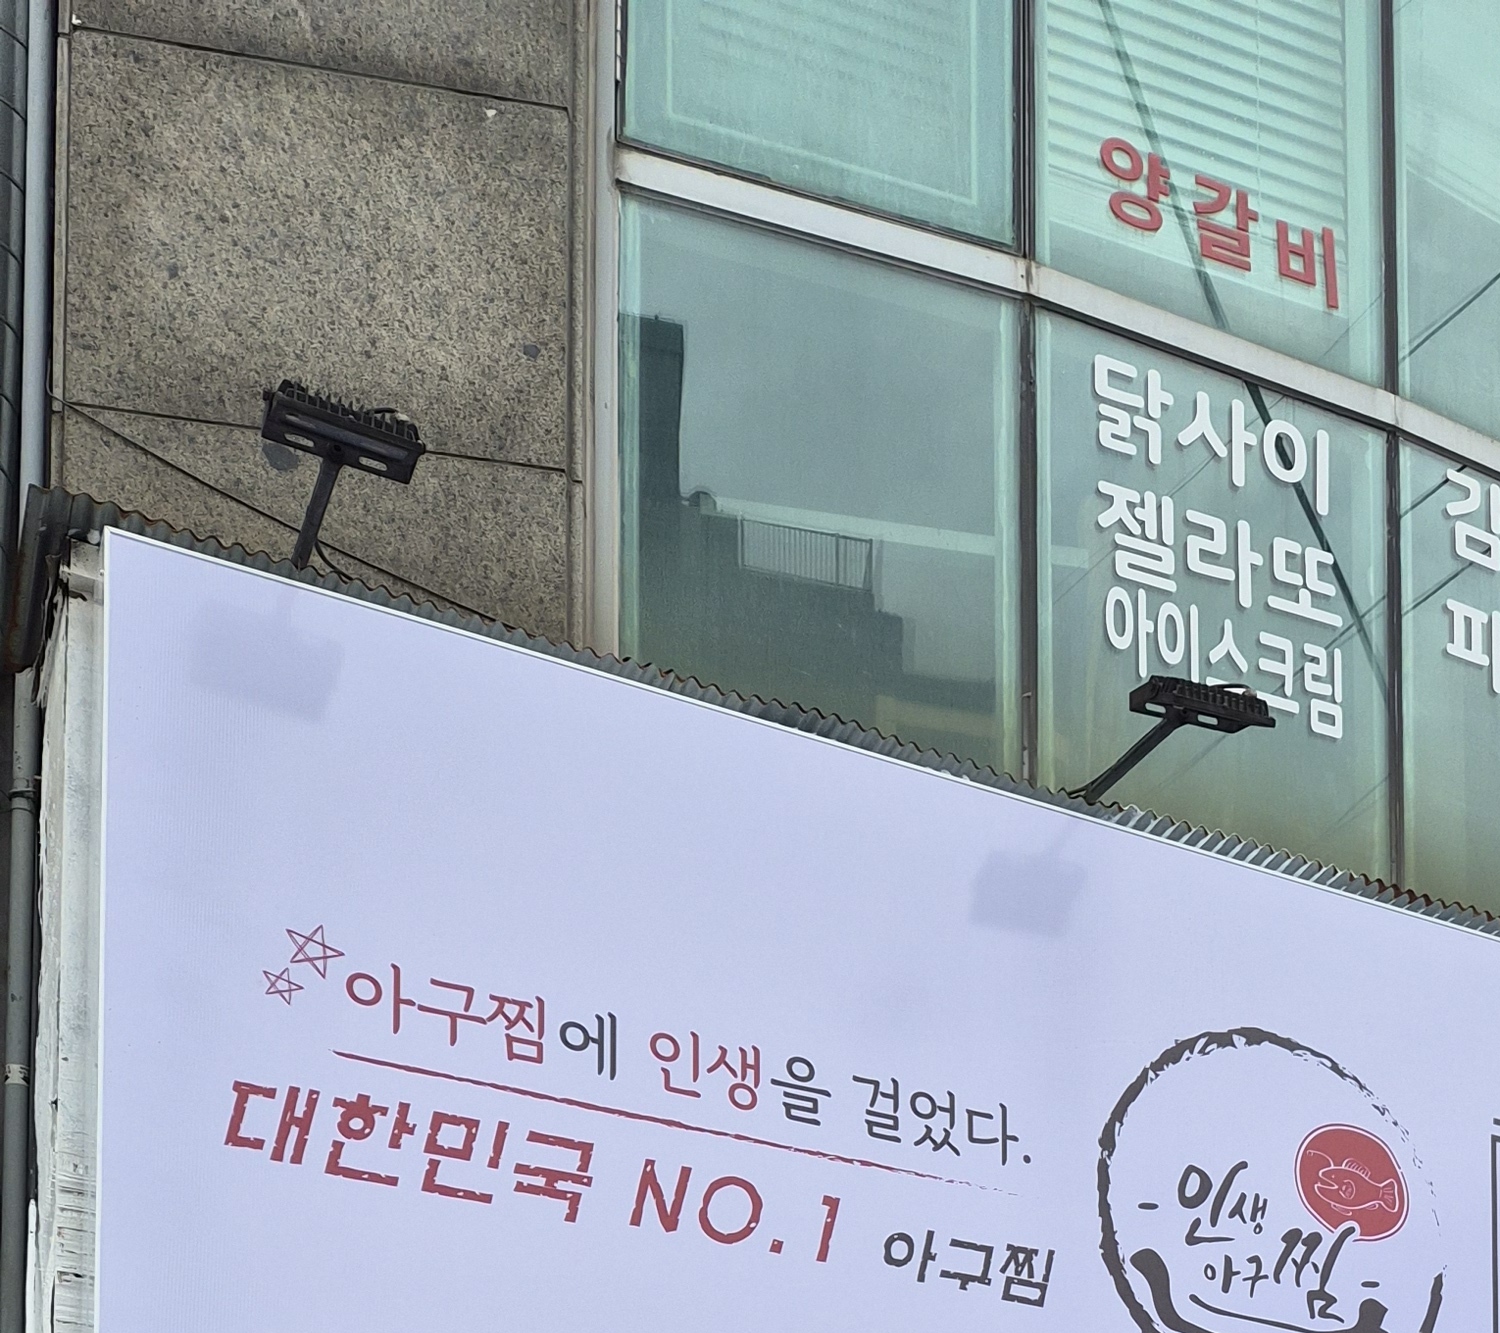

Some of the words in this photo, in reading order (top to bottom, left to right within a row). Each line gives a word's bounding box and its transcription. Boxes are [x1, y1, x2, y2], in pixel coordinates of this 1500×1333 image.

[1101, 137, 1339, 309] 양갈비
[1094, 354, 1330, 516] 닭사이
[1098, 480, 1343, 627] 젤라또
[1105, 587, 1343, 740] 아이스크림
[345, 962, 619, 1080] 아구찜에
[648, 1030, 833, 1127] 인생을
[851, 1073, 1033, 1166] 걸었다.
[223, 1080, 594, 1223] 대한민국
[882, 1229, 1057, 1308] 아구찜
